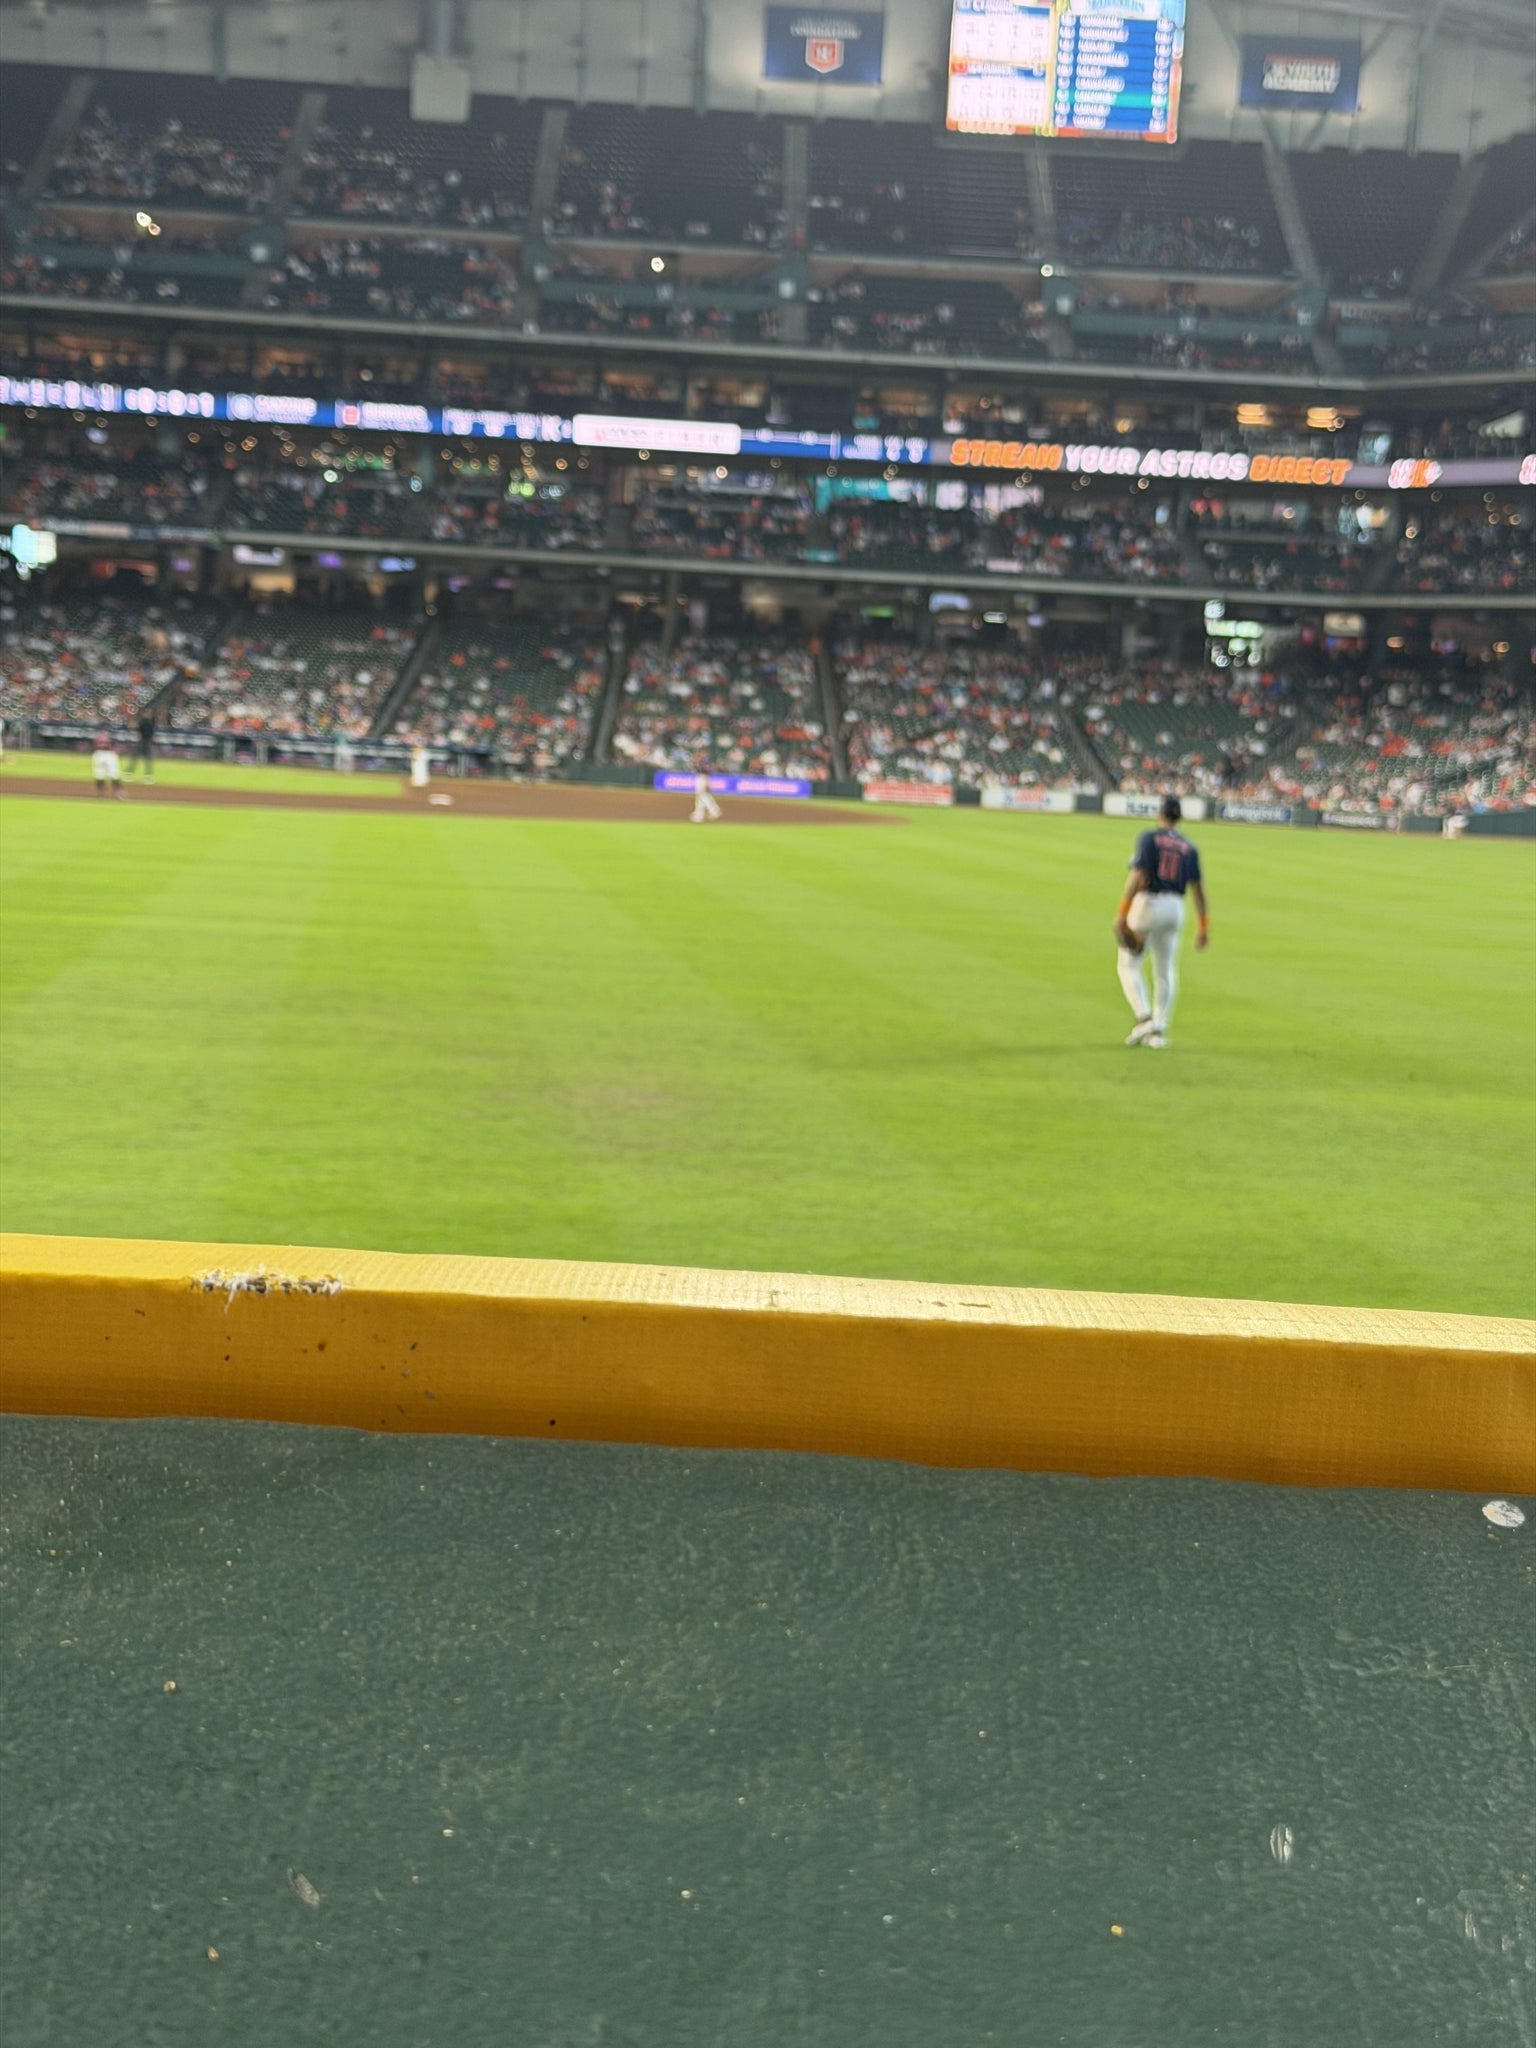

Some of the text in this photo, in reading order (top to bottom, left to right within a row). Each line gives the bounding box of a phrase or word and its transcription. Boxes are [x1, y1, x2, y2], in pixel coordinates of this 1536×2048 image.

[950, 438, 1063, 471] STREAM
[1065, 444, 1140, 475] YOUR
[1138, 448, 1249, 480] ASTROS
[1249, 454, 1352, 486] DIRECT
